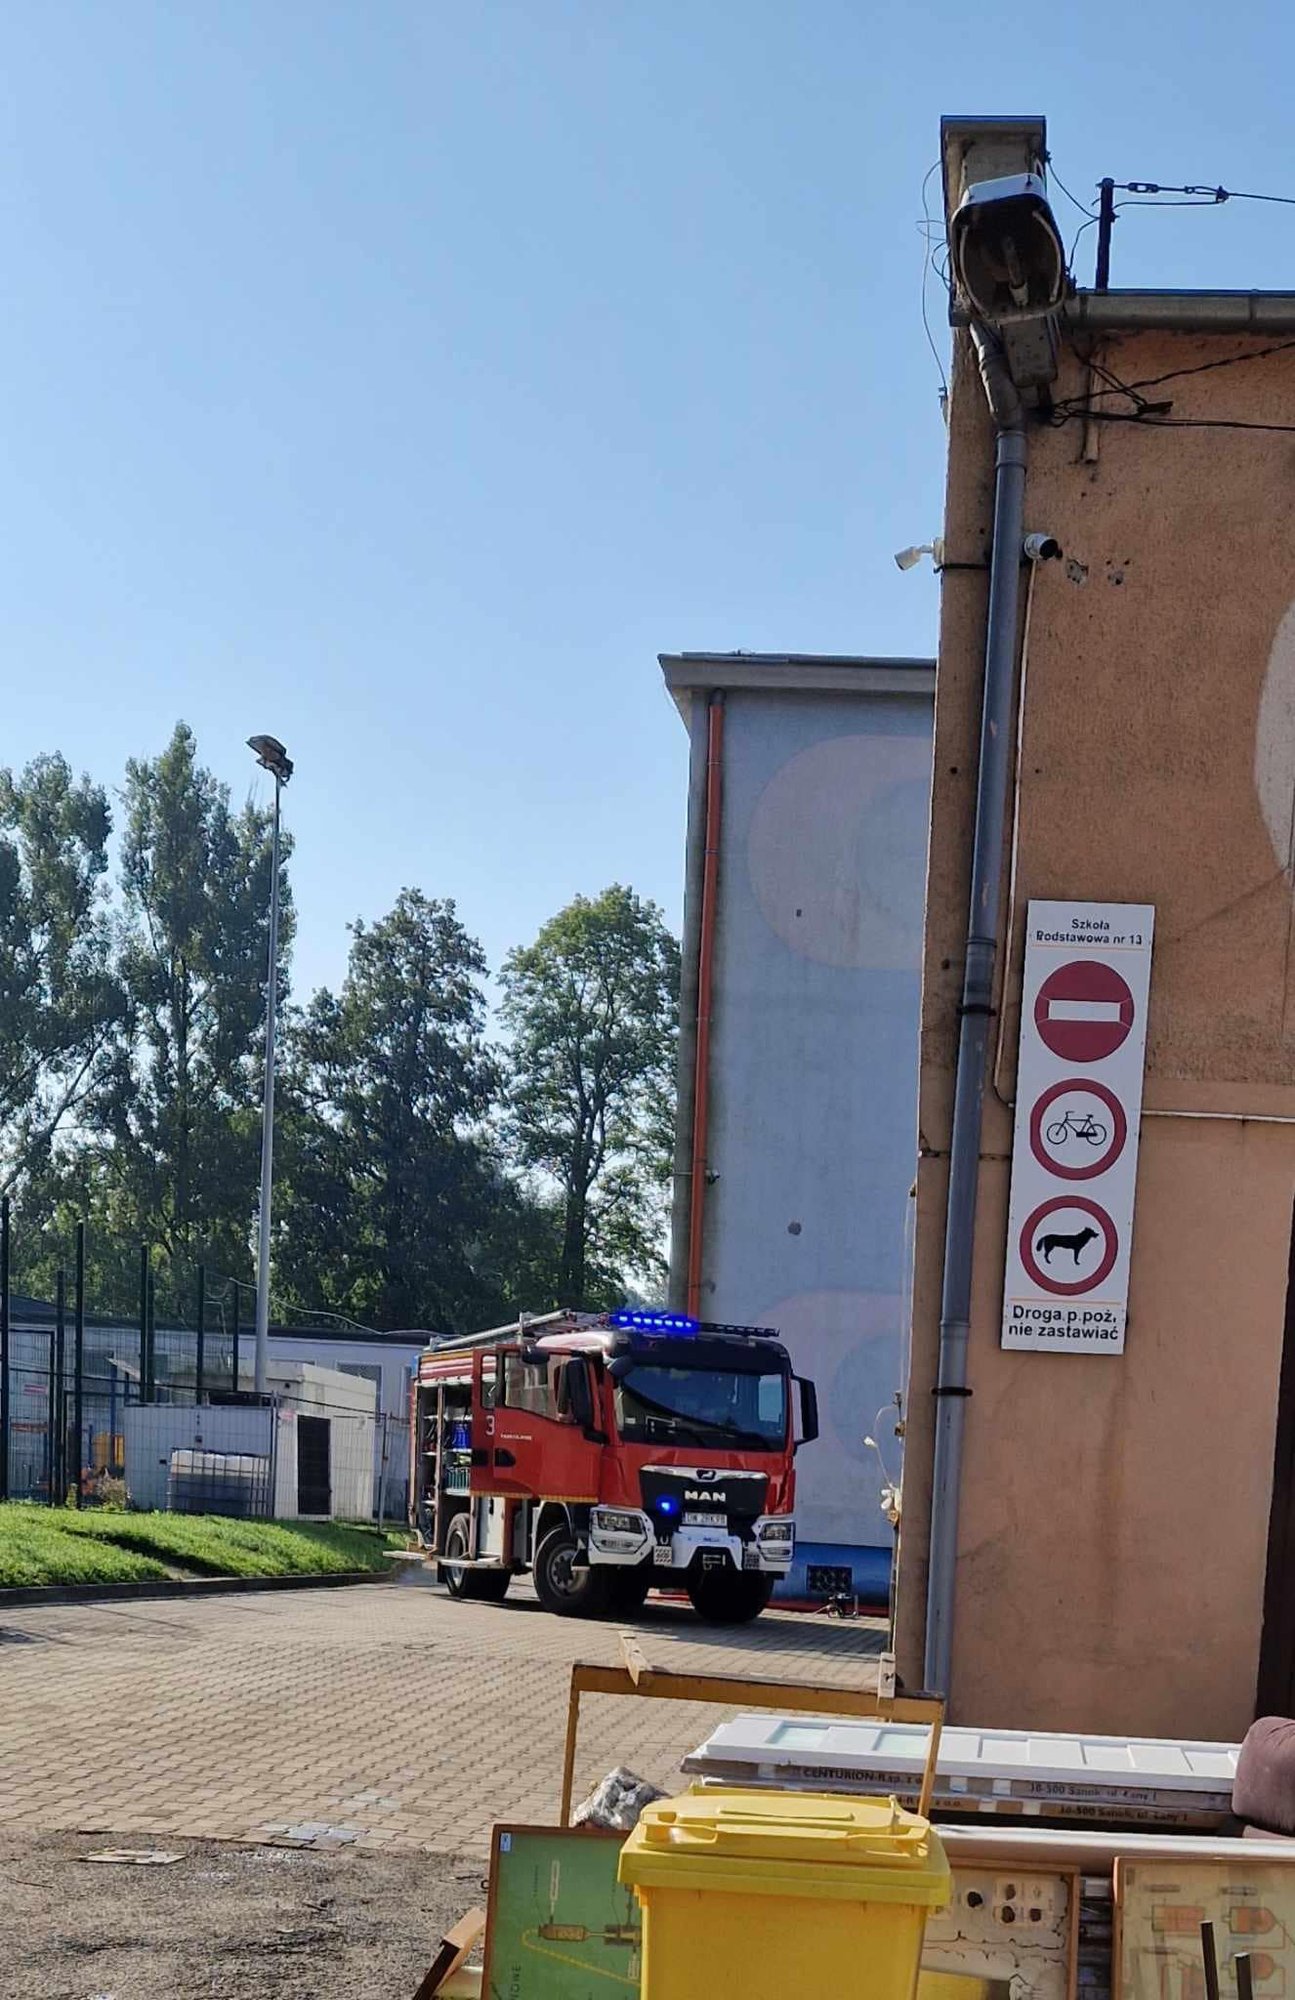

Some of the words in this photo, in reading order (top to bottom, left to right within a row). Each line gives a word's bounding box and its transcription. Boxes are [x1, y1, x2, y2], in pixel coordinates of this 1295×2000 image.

[1071, 918, 1110, 930] Szkoła
[1036, 930, 1110, 944] Podstawowa
[1113, 935, 1125, 945] nr
[1130, 934, 1142, 945] 13
[1012, 1305, 1062, 1323] Droga
[1008, 1322, 1033, 1336] nie
[1038, 1325, 1119, 1340] zastawiać
[684, 1490, 726, 1502] MAN
